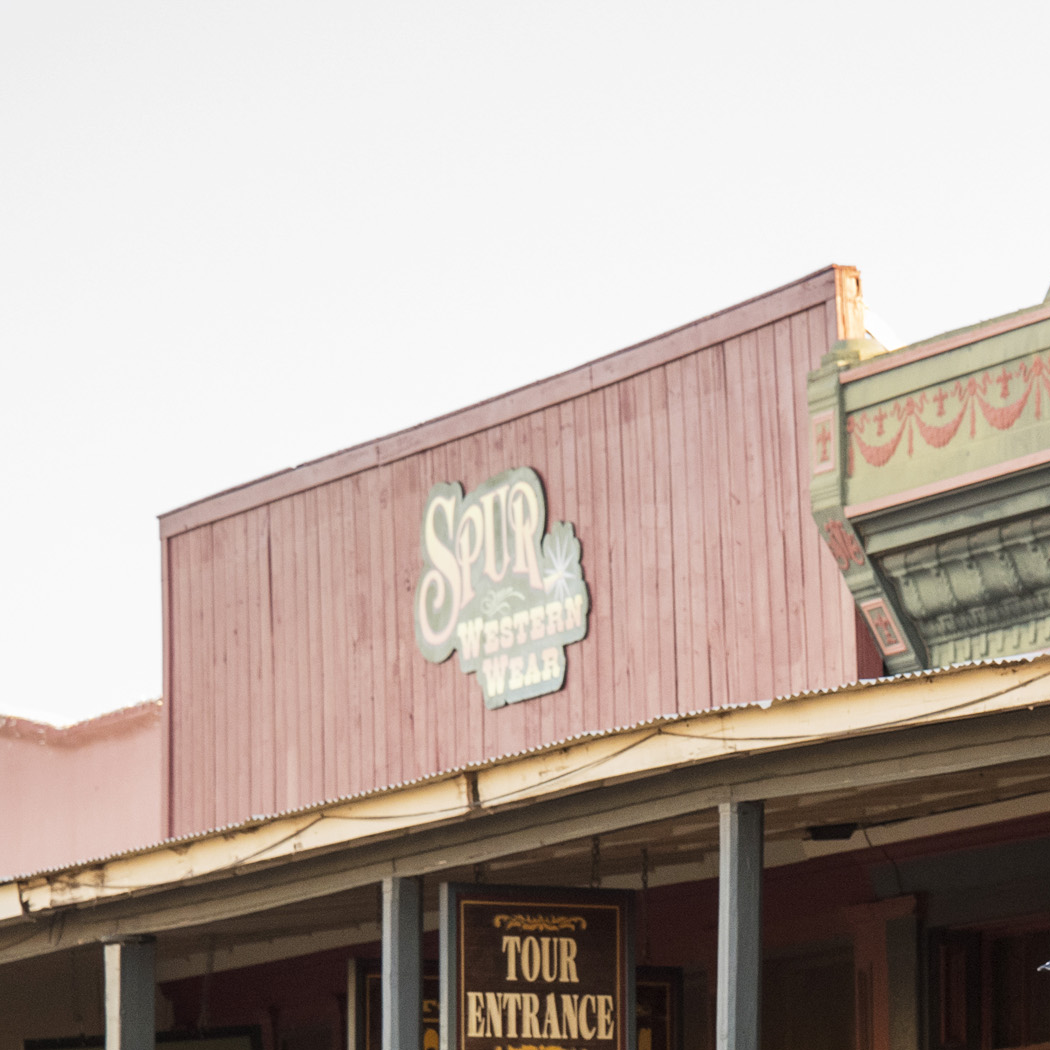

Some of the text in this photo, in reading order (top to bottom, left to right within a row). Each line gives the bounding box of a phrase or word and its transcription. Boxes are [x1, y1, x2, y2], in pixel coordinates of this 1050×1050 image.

[457, 594, 584, 662] WESTERN
[482, 647, 561, 698] WEAR
[502, 936, 579, 983] TOUR
[466, 991, 615, 1041] ENTRANCE
